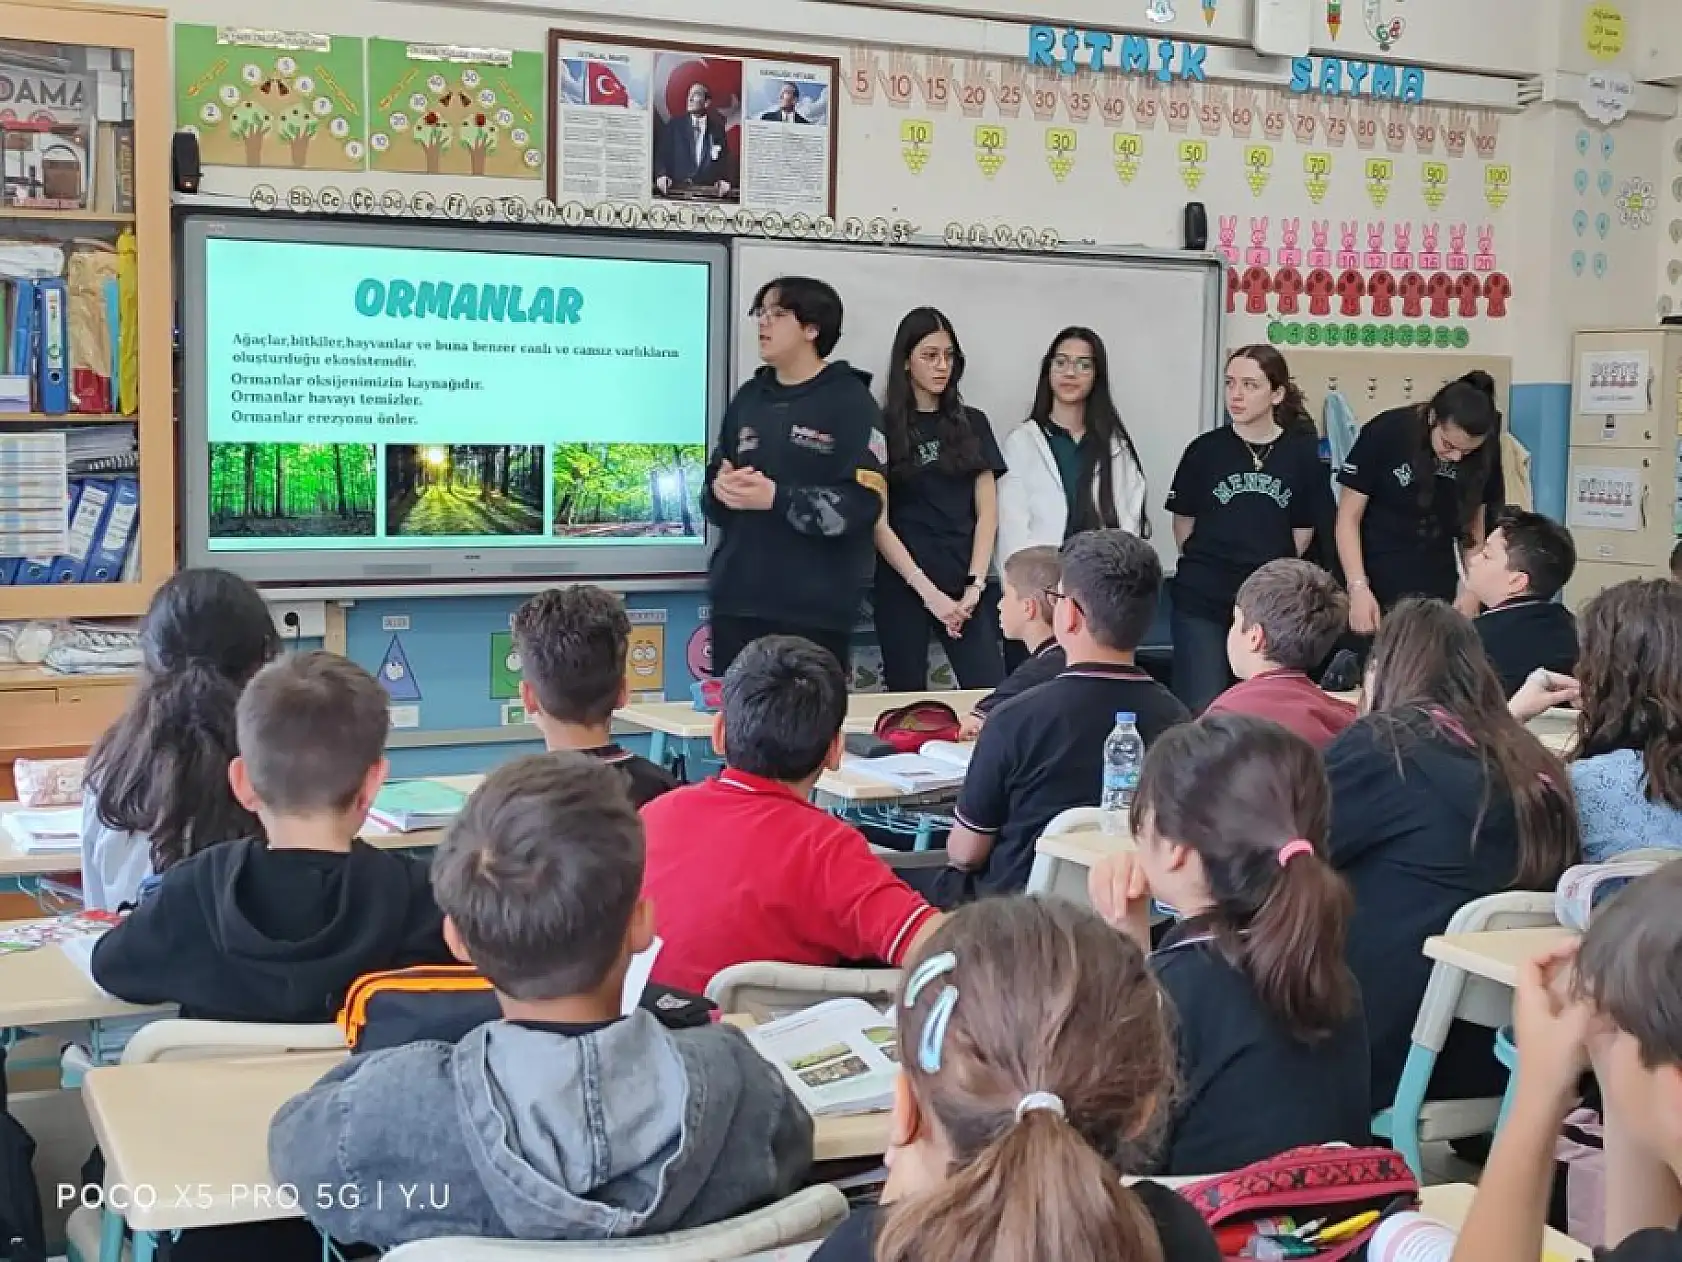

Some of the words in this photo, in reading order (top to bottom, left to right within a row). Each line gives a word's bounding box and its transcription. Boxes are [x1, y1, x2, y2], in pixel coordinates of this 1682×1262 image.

[1290, 57, 1425, 104] SAYMA
[856, 70, 867, 93] 5
[890, 75, 912, 97] 10
[927, 78, 947, 100] 15
[964, 86, 985, 105] 20
[1001, 85, 1021, 104] 25
[1035, 90, 1055, 109] 30
[1070, 92, 1090, 111] 35
[1104, 98, 1124, 116] 40
[1136, 99, 1155, 117] 45
[1169, 102, 1189, 119] 50
[1201, 104, 1221, 123] 55
[1232, 108, 1251, 125] 60
[1266, 112, 1284, 130] 65
[1297, 115, 1315, 133] 70
[1328, 117, 1346, 135] 75
[1387, 122, 1405, 140] 85
[1416, 126, 1435, 143] 90
[1448, 130, 1465, 147] 95
[908, 126, 926, 143] 10
[981, 131, 1000, 148] 20
[1052, 134, 1070, 150] 30
[1119, 139, 1136, 155] 40
[1184, 144, 1202, 161] 50
[1250, 149, 1267, 167] 60
[1309, 157, 1326, 174] 70
[1488, 169, 1508, 183] 100
[355, 278, 584, 324] ORMANLAR
[416, 342, 431, 350] ve
[435, 339, 468, 352] buna
[472, 341, 516, 354] benzer
[555, 345, 568, 355] ve
[232, 351, 320, 367] oluşturduğu
[324, 354, 416, 368] ekosistemdir.
[231, 372, 303, 387] Ormanlar
[307, 374, 403, 390] oksijenimizin
[407, 376, 484, 392] kaynağıdır.
[231, 389, 304, 404] Ormanlar
[308, 391, 356, 407] havayı
[360, 393, 423, 406] temizler.
[231, 409, 301, 424] Ormanlar
[307, 413, 372, 426] erezyonu
[377, 411, 418, 425] önler.
